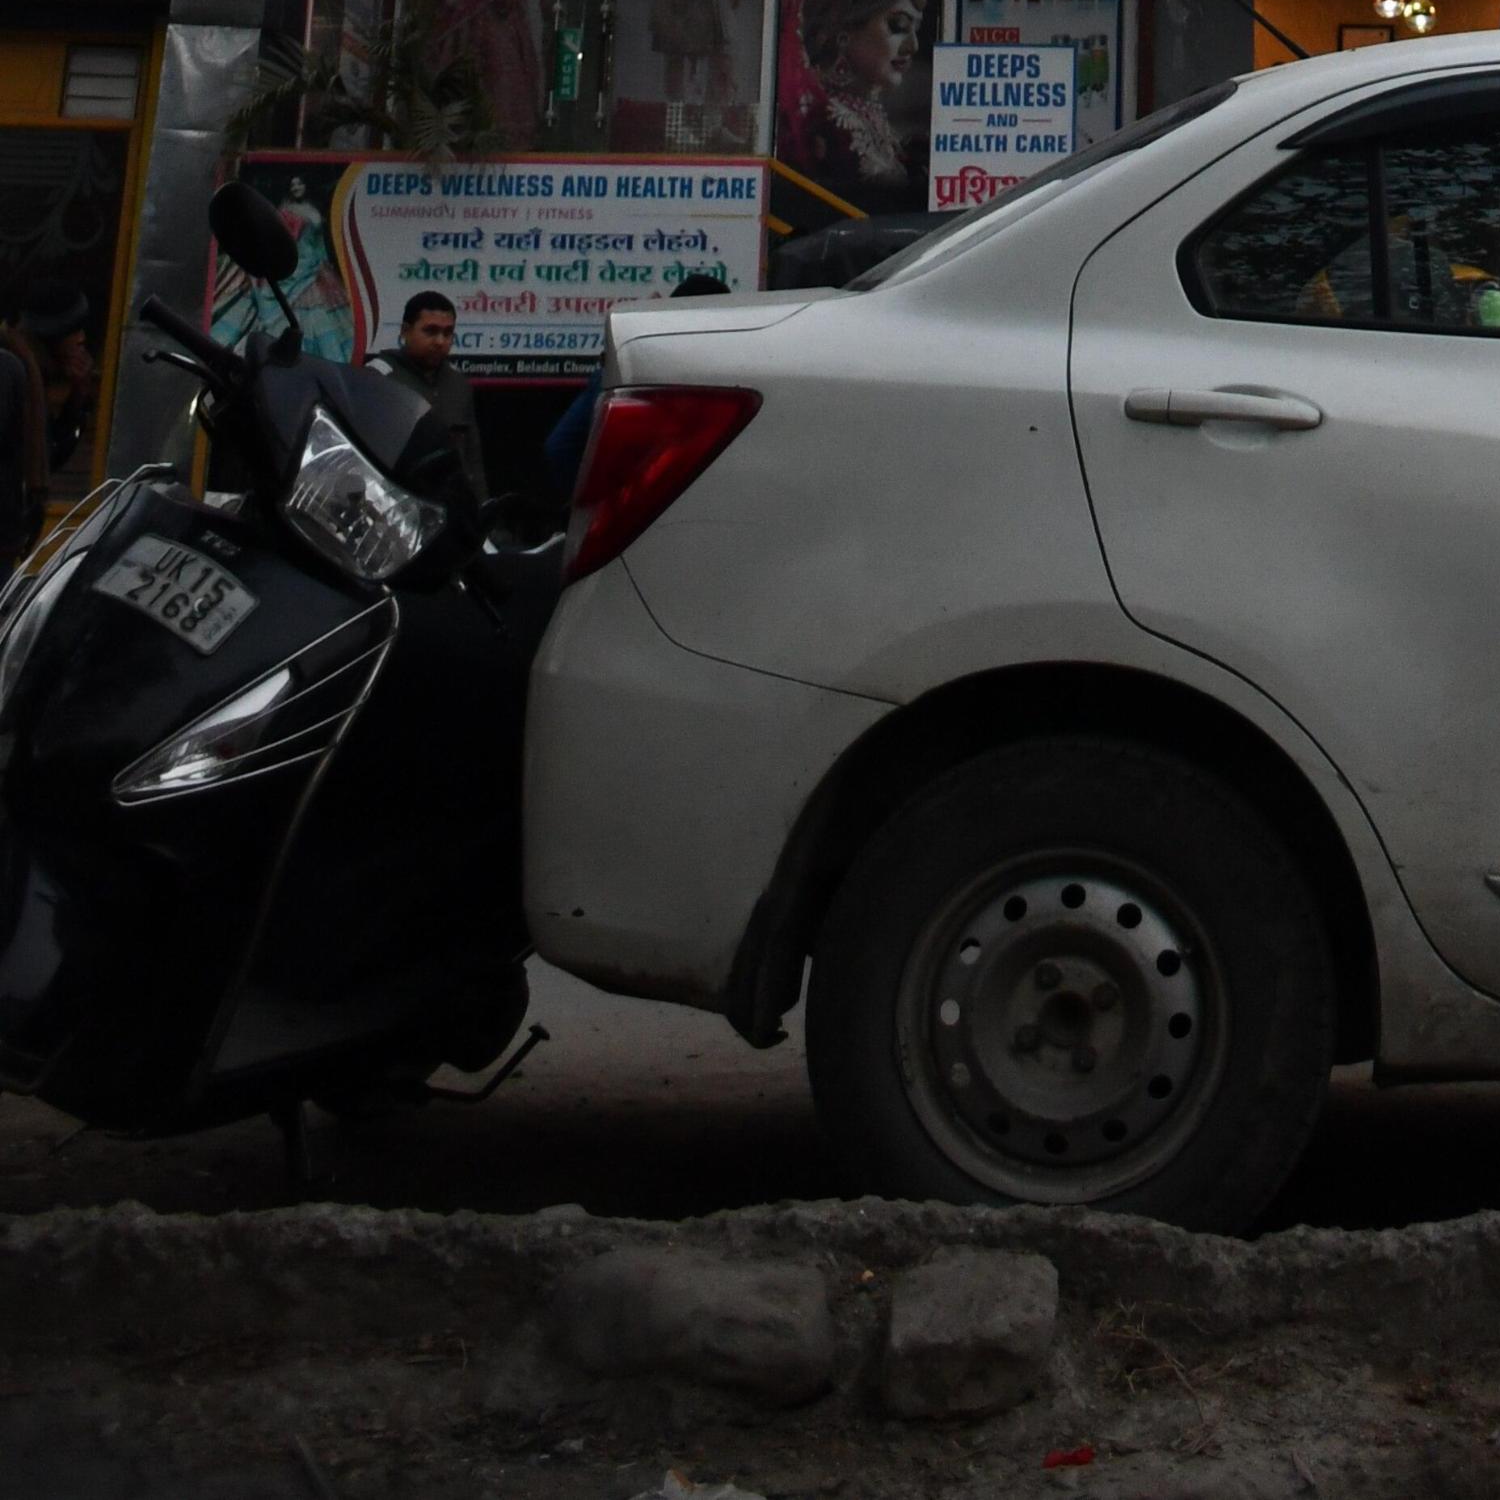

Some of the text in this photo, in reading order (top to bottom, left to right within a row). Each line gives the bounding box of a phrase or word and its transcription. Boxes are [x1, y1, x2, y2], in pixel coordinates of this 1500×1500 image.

[967, 53, 1041, 78] DEEPS
[939, 82, 1067, 107] WELLNESS
[986, 113, 1018, 127] AND
[935, 134, 1068, 153] HEALTH CARE
[367, 172, 757, 200] DEEPS WELLNESS AND HEALTH CARE
[463, 206, 519, 219] BEAUTY
[537, 207, 594, 220] FITNESS
